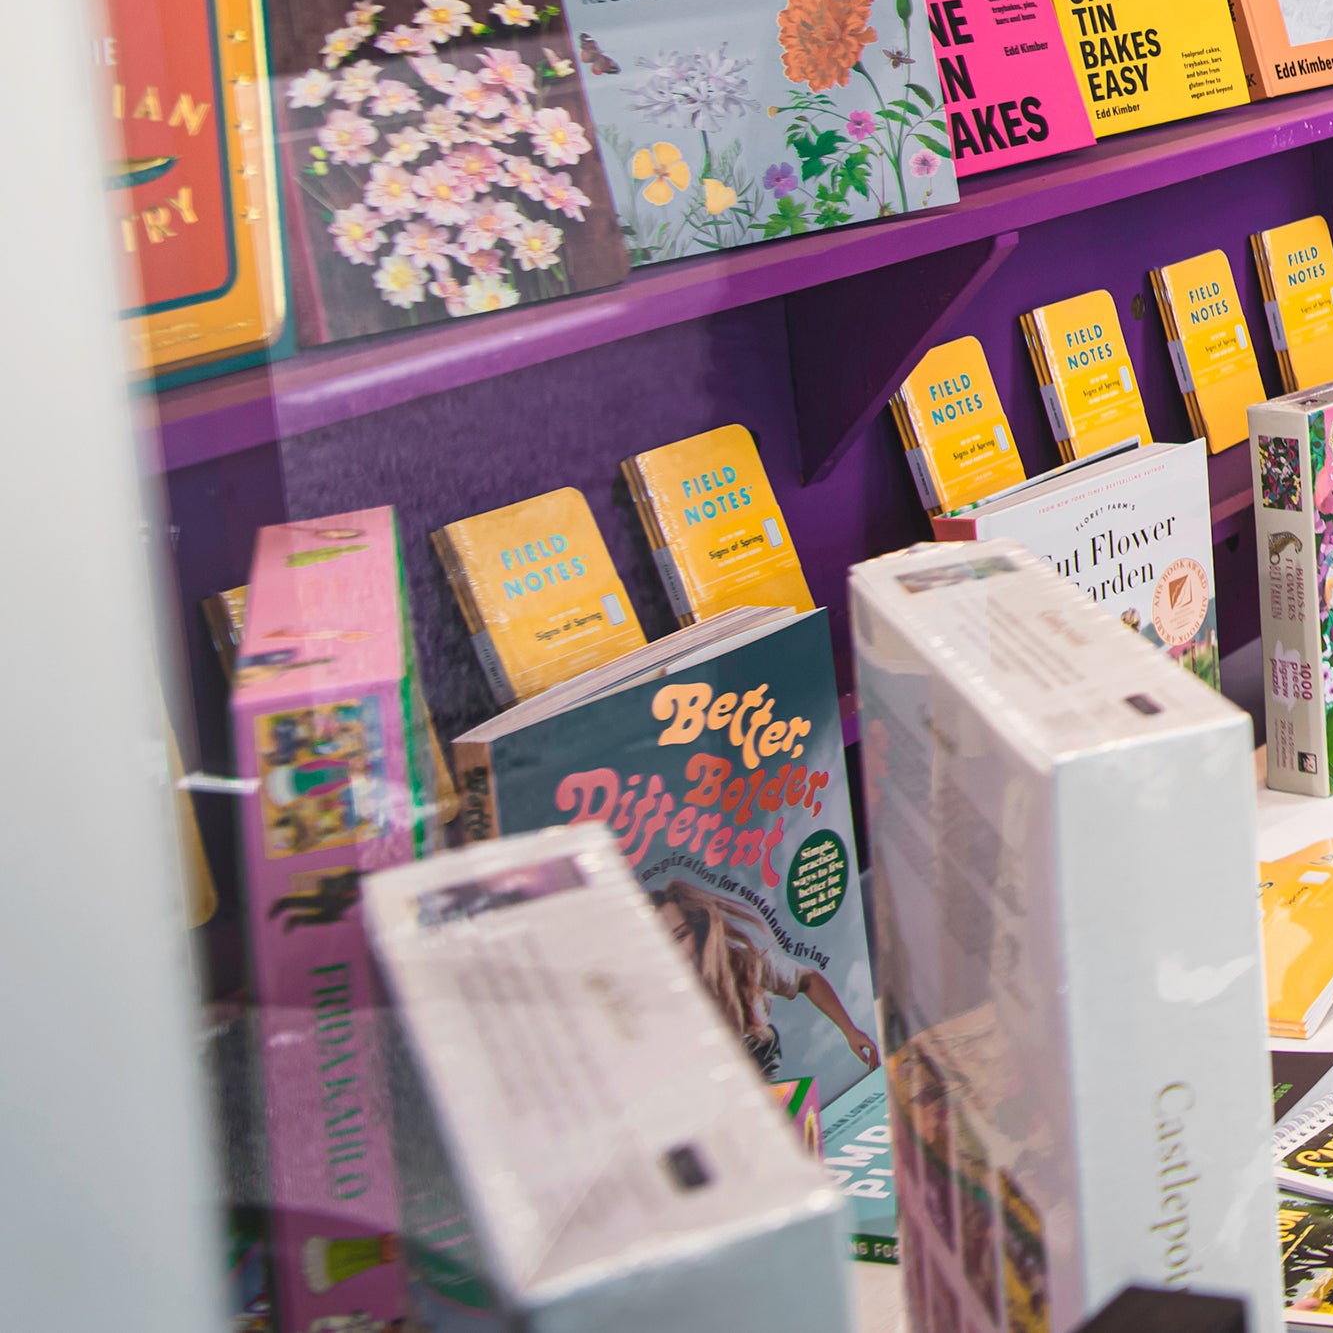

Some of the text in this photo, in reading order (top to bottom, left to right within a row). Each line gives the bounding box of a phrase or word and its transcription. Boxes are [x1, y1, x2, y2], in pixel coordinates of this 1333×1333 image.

[1072, 3, 1117, 37] TIN
[1003, 41, 1049, 57] Edd Kimber
[1079, 28, 1162, 70] BAKES
[1087, 63, 1149, 103] EASY
[1274, 60, 1295, 80] Edd
[950, 96, 1049, 160] AKES
[1096, 103, 1140, 120] Edd Kimber
[1287, 246, 1318, 267] FIELD
[1287, 263, 1326, 287] NOTES
[1188, 282, 1220, 304] FIELD
[1190, 300, 1229, 325] NOTES
[1066, 324, 1103, 347] FIELD
[1067, 343, 1113, 370] NOTES
[928, 374, 971, 402] FIELD
[931, 393, 983, 426] NOTES
[681, 465, 737, 499] FIELD
[683, 489, 753, 526] NOTES
[1075, 507, 1105, 532] FLORET
[500, 533, 568, 571] FIELD
[739, 532, 764, 550] Spring
[1090, 516, 1176, 567] Flower
[502, 557, 588, 601] NOTES
[1290, 661, 1300, 700] piece
[1300, 663, 1313, 702] 1000
[651, 682, 812, 769] Better,
[683, 752, 829, 826] Bolder,
[554, 766, 784, 889] Different
[798, 848, 839, 877] practical
[792, 872, 817, 888] ways
[798, 880, 828, 899] better
[718, 873, 830, 971] for sustainable living
[806, 899, 836, 923] planet
[309, 962, 357, 1072] FRIDA
[1149, 1080, 1203, 1294] Castlepoi
